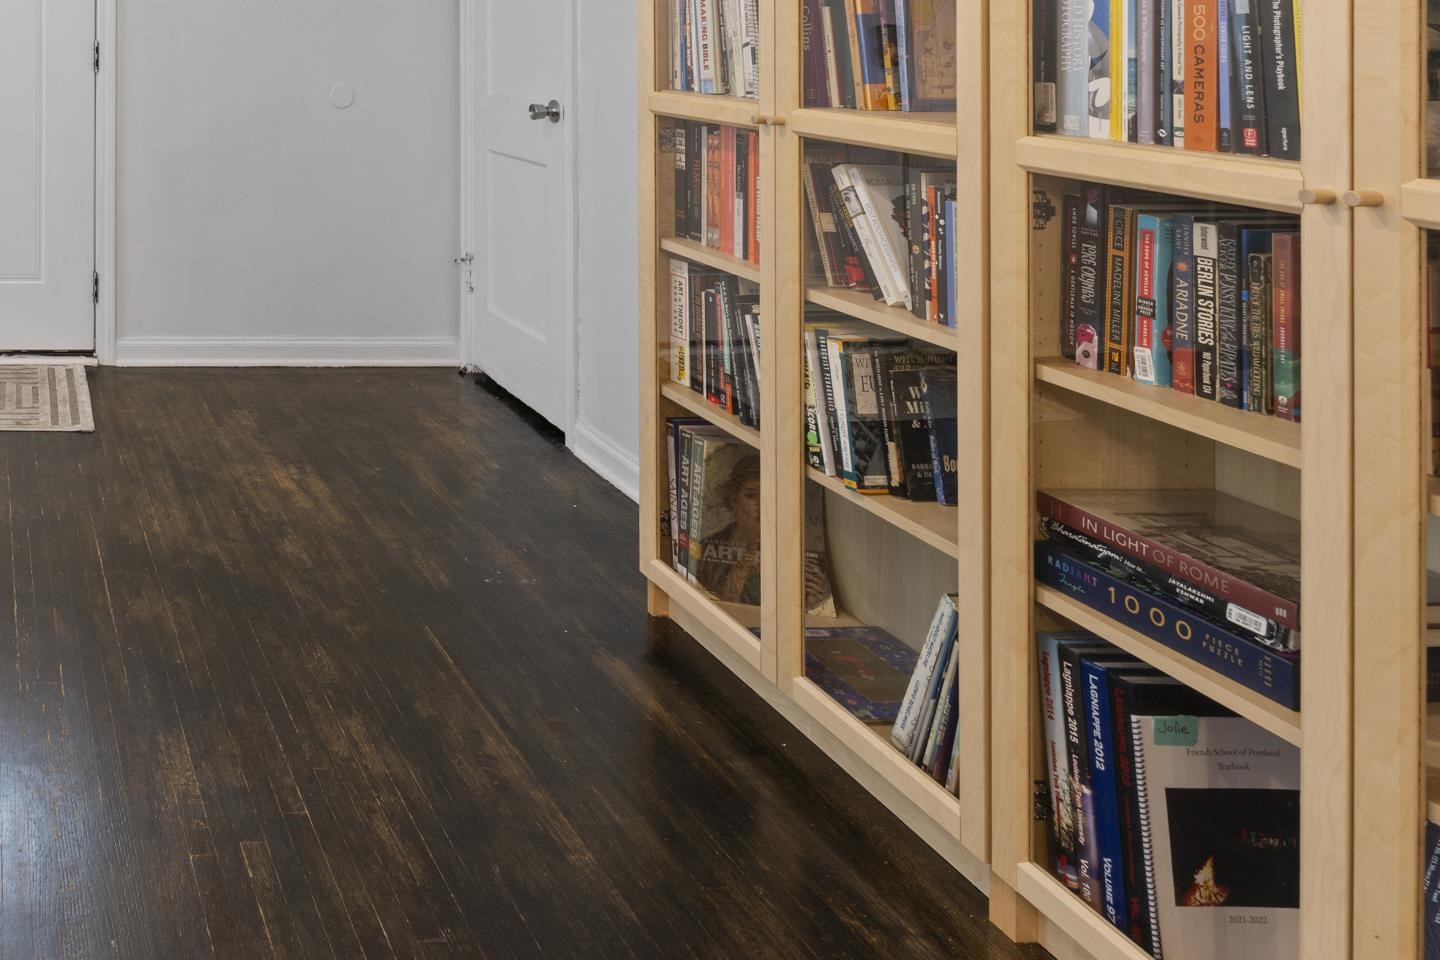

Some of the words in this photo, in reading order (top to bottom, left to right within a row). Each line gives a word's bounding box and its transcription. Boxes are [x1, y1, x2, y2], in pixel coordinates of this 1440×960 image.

[1193, 4, 1206, 41] 500
[1272, 10, 1284, 59] Photographer's
[702, 43, 710, 71] BIBLE
[1073, 19, 1084, 73] HISTORY
[1242, 25, 1251, 58] LIGHT
[1193, 44, 1205, 124] CAMERAS
[1243, 63, 1252, 84] AND
[1275, 61, 1286, 90] Playbook
[1246, 85, 1255, 110] LENS
[1281, 127, 1289, 151] aperture
[1114, 219, 1123, 249] CIRCE
[1080, 241, 1097, 266] LORE
[1078, 266, 1097, 304] OLYMPUS
[1112, 257, 1124, 306] MADELINE
[1197, 257, 1214, 297] BERLIN
[1112, 308, 1122, 341] MILLER
[1175, 277, 1189, 340] ARIADNE
[1197, 299, 1214, 345] STORIES
[820, 335, 829, 370] ANARCHIST
[1220, 342, 1236, 383] PIRATES
[1202, 360, 1211, 384] Paperbook
[824, 373, 835, 412] PEDAGOGIES
[680, 454, 690, 486] ART
[690, 462, 702, 492] ART
[680, 488, 690, 530] AGES
[690, 497, 702, 539] AGES
[1081, 515, 1098, 534] IN
[1104, 525, 1150, 556] LIGHT
[1152, 548, 1175, 568] OF
[1179, 558, 1231, 595] ROME
[1047, 555, 1099, 588] RADIANT
[1168, 575, 1215, 603] JAYALAKSHMI
[1176, 587, 1206, 605] ESHWAR
[1201, 638, 1245, 668] PUZZLE
[1204, 632, 1241, 656] PIECE
[1062, 661, 1076, 715] Lagniappe
[1088, 673, 1102, 737] LAGNIAPPE
[1068, 717, 1078, 744] 2015
[1158, 721, 1191, 735] Jolie
[1094, 739, 1105, 771] 2012
[1186, 747, 1213, 757] Friends
[1213, 747, 1238, 757] School
[1238, 747, 1247, 756] of
[1248, 747, 1281, 758] Portland
[1217, 762, 1250, 771] Yearbook
[1071, 754, 1080, 791] Louisiana
[1076, 808, 1086, 846] University
[1080, 858, 1090, 877] Vol.
[1102, 857, 1114, 904] VOLUME
[1082, 882, 1092, 902] 100
[1106, 905, 1117, 924] 97
[1228, 915, 1268, 924] 2021-2022
